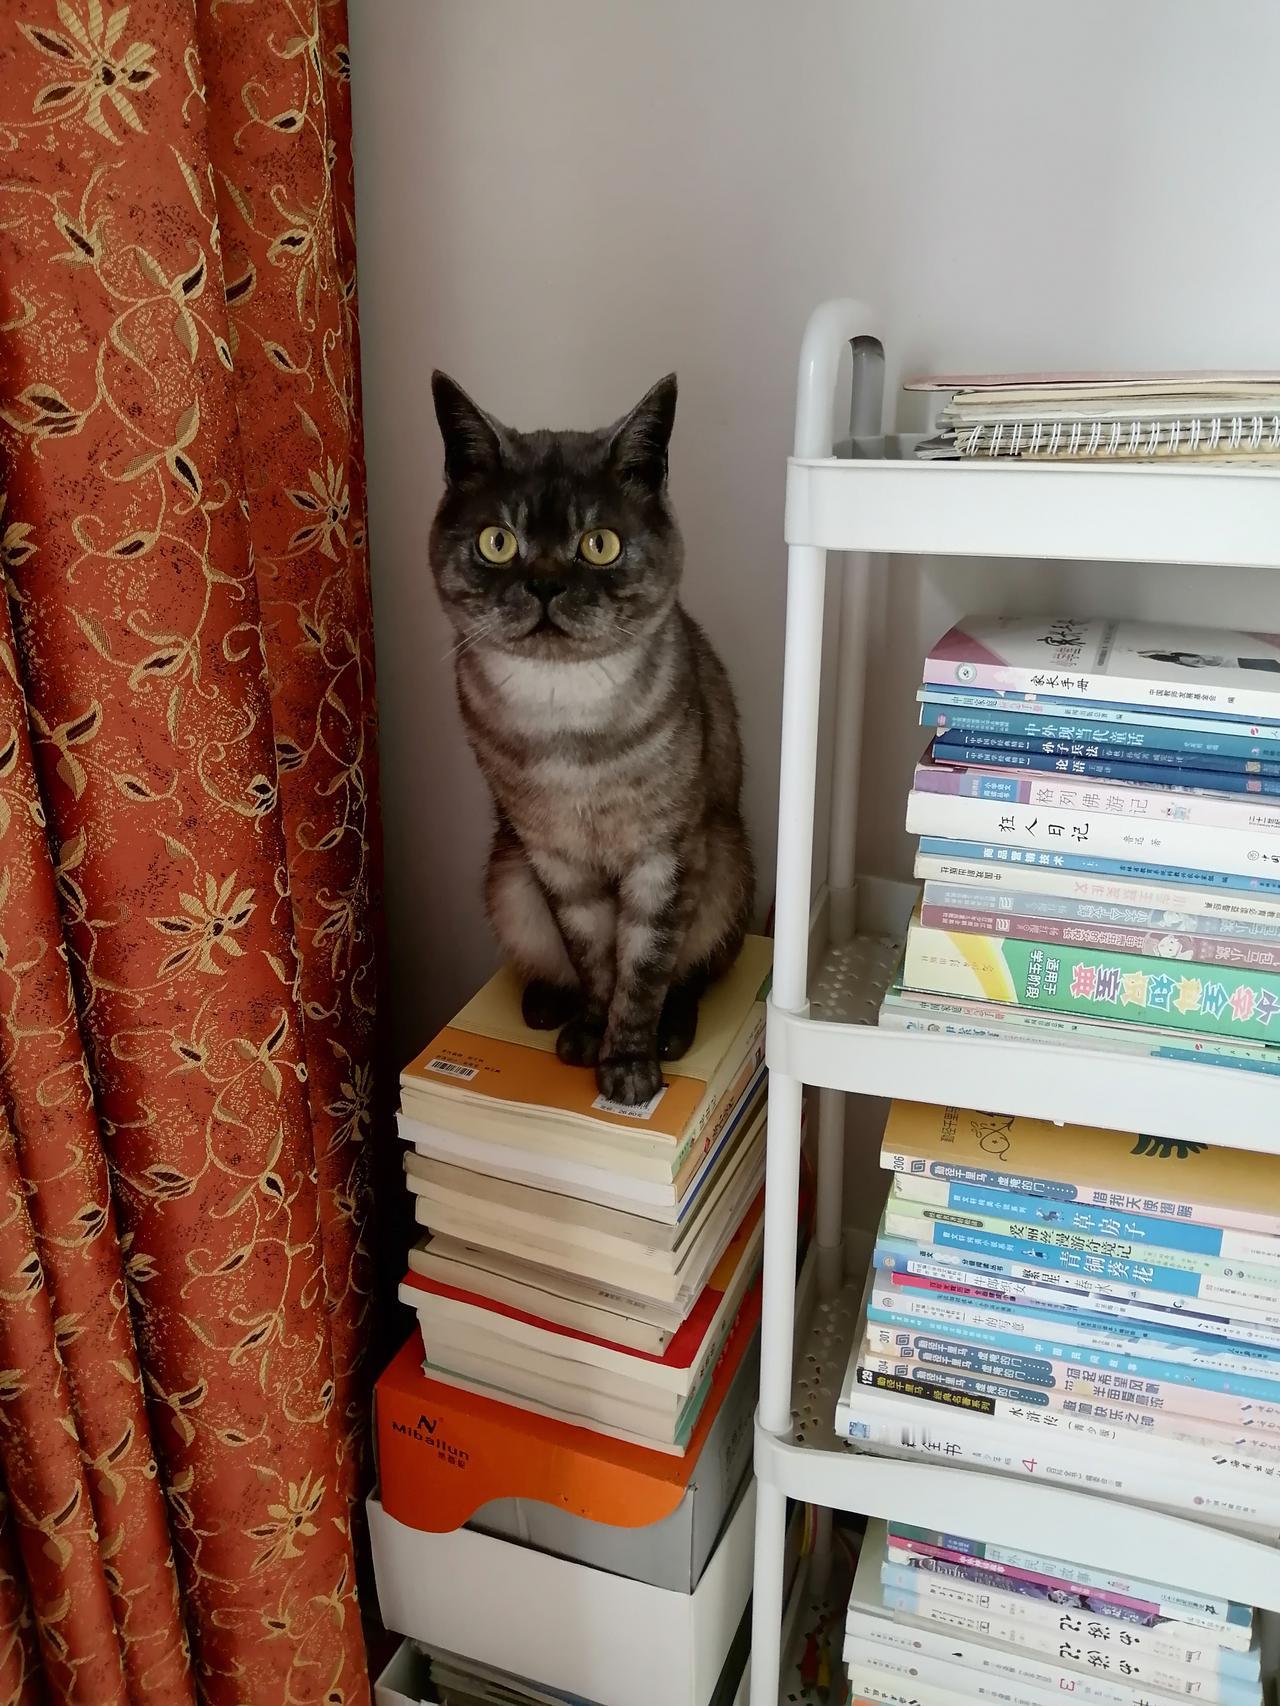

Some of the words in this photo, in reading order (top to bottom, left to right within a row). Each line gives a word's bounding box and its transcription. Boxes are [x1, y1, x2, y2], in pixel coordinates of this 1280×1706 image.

[1030, 675, 1089, 693] 家长手册
[1024, 724, 1145, 747] 中外现当代童话
[1042, 741, 1098, 758] 孙子兵法
[1055, 759, 1086, 773] 论语
[1036, 788, 1149, 814] 格列佛游记
[999, 816, 1089, 843] 狂人日记
[983, 847, 1065, 866] 商品营销技术
[940, 866, 1002, 881] 中国戏剧出版社
[1026, 949, 1045, 999] 学生阶段
[1045, 957, 1061, 997] 适用于
[893, 1155, 905, 1170] 306
[1073, 1212, 1146, 1238] 草房子
[1008, 1224, 1132, 1261] 爱丽丝漫游奇境记
[1059, 1250, 1154, 1284] 青铜葵花
[1022, 1269, 1112, 1293] 繁星·春水
[880, 1330, 889, 1344] 301
[878, 1361, 888, 1376] 304
[1034, 1344, 1138, 1372] 中国民间故事
[861, 1370, 873, 1384] 129
[1008, 1408, 1058, 1427] 水浒传
[392, 1421, 469, 1461] Mibailun
[1022, 1458, 1037, 1473] 4
[1059, 1614, 1140, 1646] 西游记
[1059, 1642, 1140, 1675] 西游记
[1059, 1678, 1075, 1692] 3
